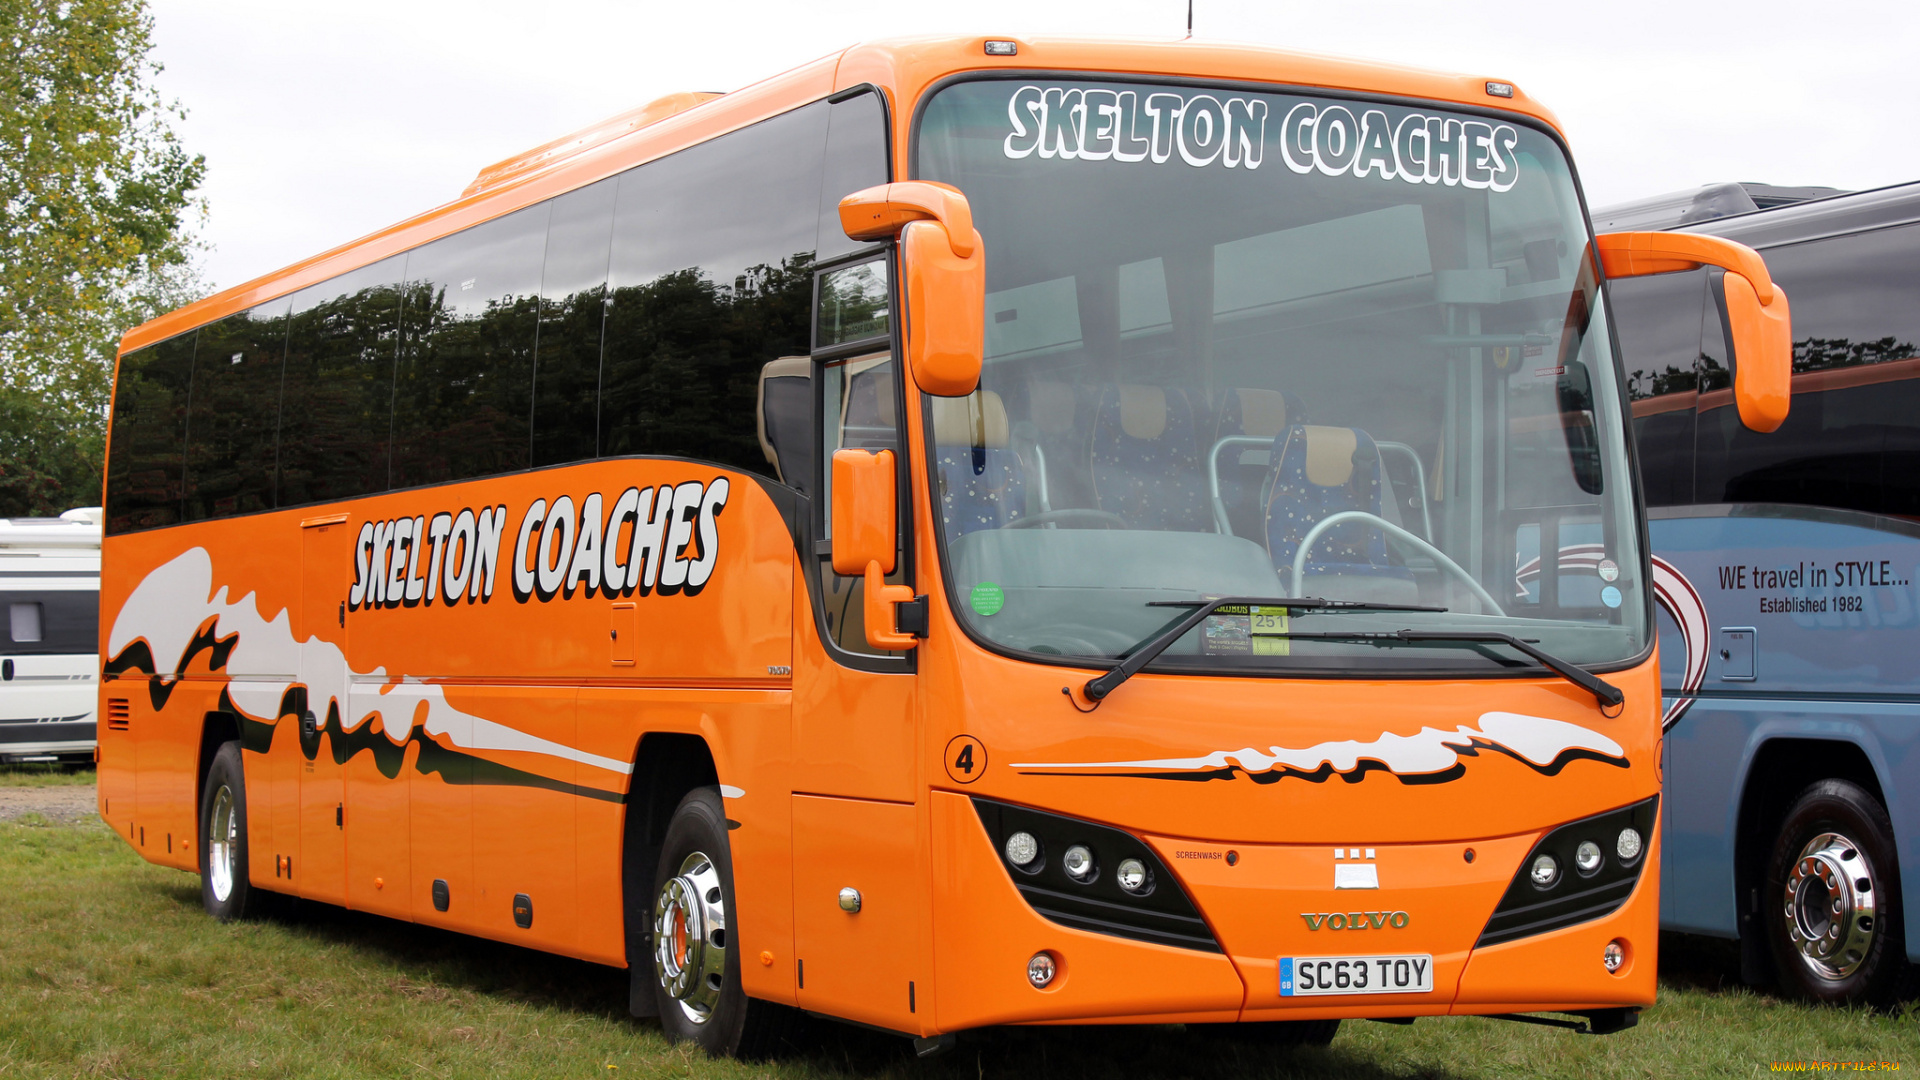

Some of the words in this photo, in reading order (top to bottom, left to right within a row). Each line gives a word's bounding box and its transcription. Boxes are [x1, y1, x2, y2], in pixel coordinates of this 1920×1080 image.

[1003, 86, 1267, 169] SKELTON
[1280, 102, 1519, 192] COACHES
[349, 504, 506, 612] SKELTON
[511, 476, 730, 603] COACHES
[1719, 565, 1746, 590] WE
[1752, 561, 1804, 589] travel
[1811, 561, 1827, 588] in
[1834, 560, 1909, 588] STYLE...
[1760, 596, 1827, 613] Established
[1832, 596, 1863, 612] 1982
[1256, 614, 1284, 628] 251
[955, 744, 974, 774] 4
[1175, 851, 1223, 860] SCREENWASH
[1300, 910, 1410, 931] VOLVO
[1281, 981, 1292, 990] GB
[1299, 960, 1368, 990] SC63
[1376, 958, 1427, 988] TOY
